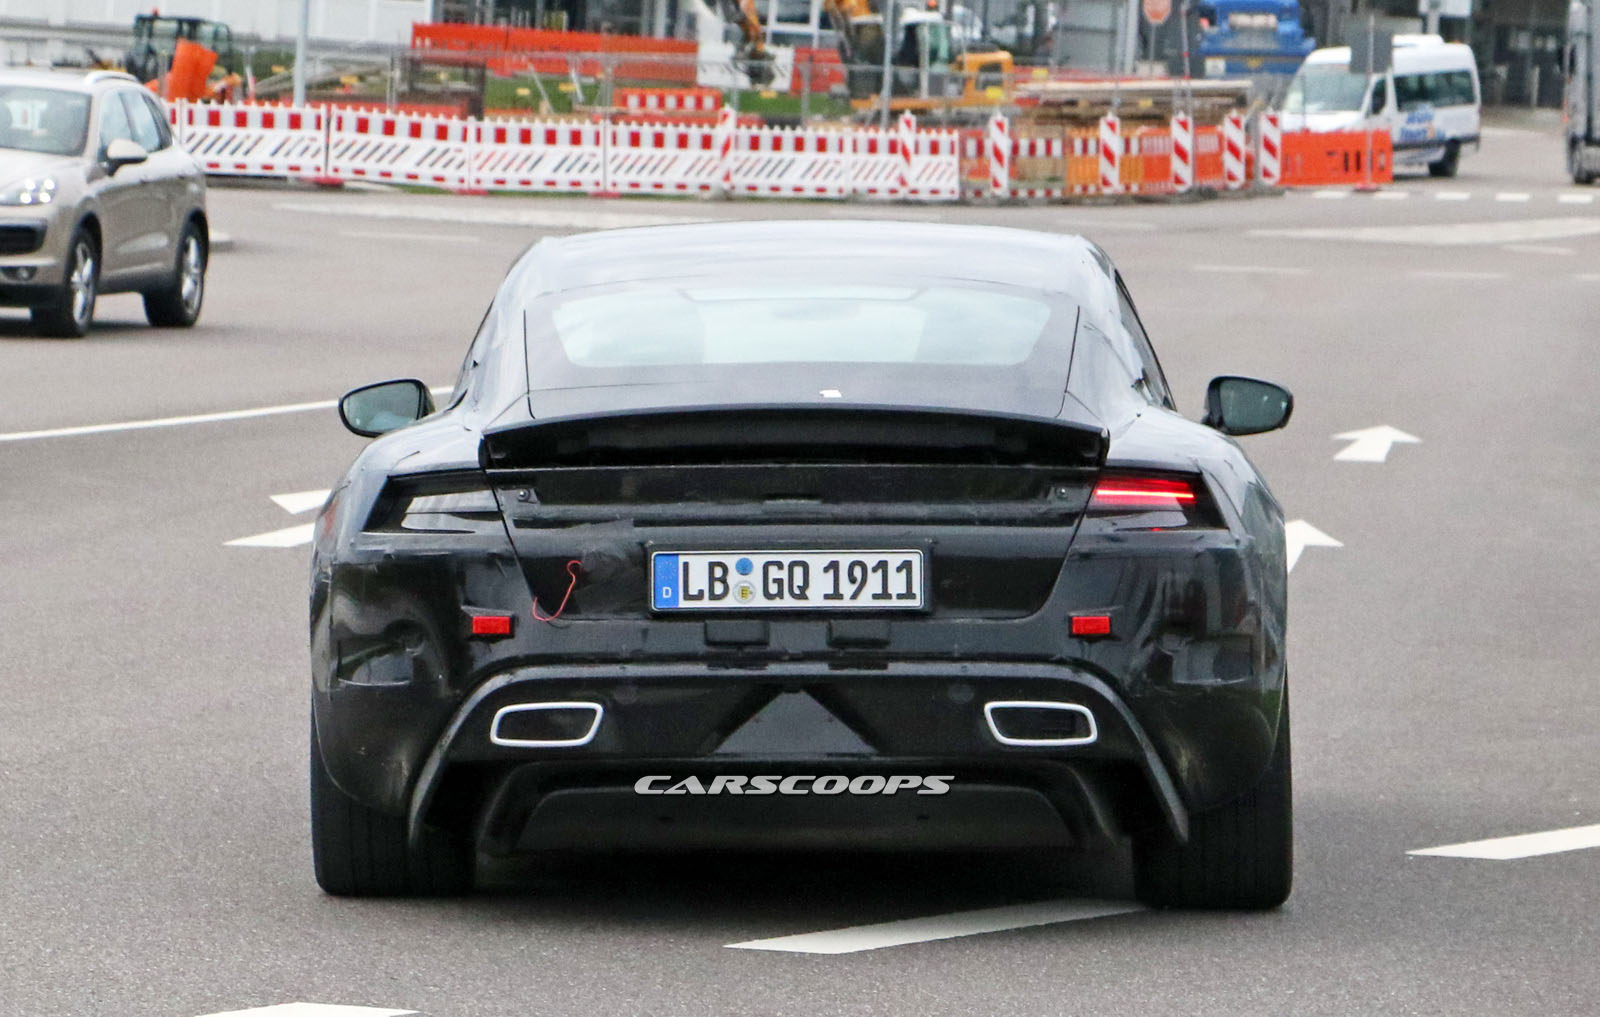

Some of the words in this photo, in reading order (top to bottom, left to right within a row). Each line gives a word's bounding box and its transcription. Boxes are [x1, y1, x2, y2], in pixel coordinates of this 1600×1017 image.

[662, 587, 672, 599] D
[682, 561, 729, 601] LB
[762, 560, 810, 600] GQ
[823, 560, 917, 600] 1911
